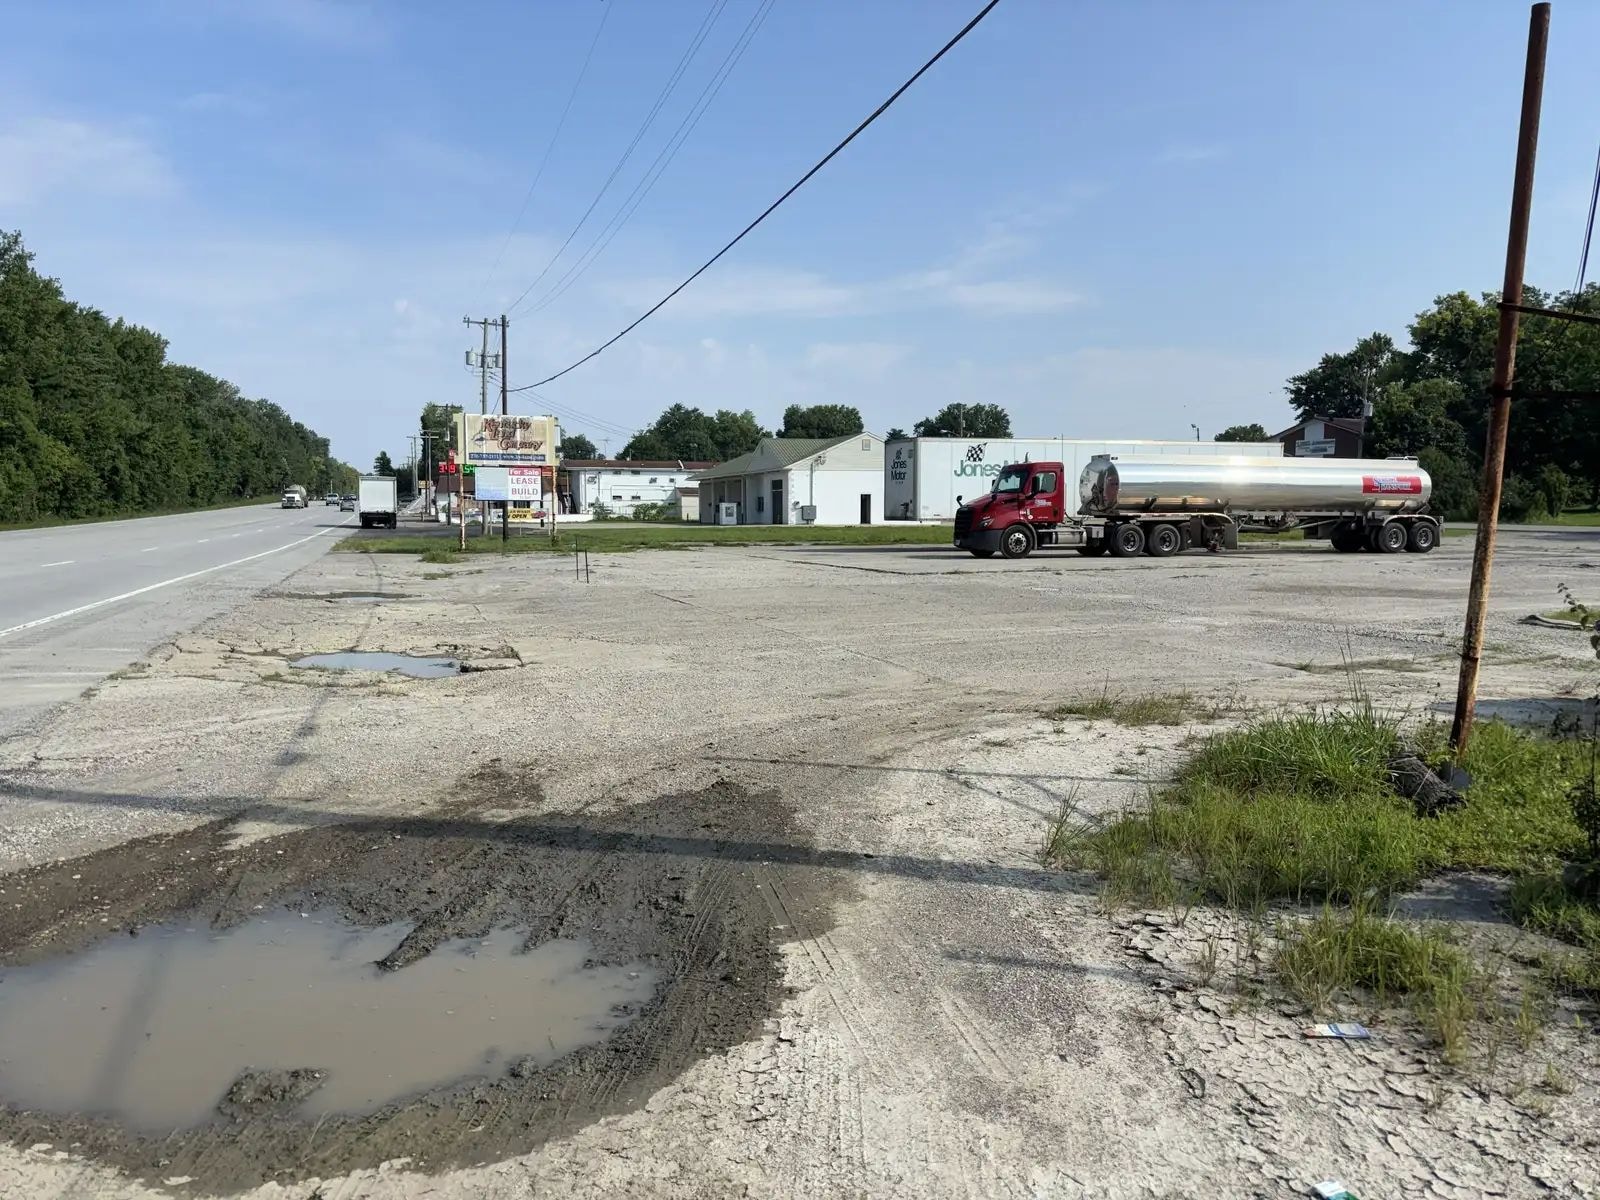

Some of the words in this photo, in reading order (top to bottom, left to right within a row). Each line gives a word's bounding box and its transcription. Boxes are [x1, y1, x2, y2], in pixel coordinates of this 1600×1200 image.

[498, 438, 543, 450] Company
[891, 460, 907, 469] Jones
[954, 460, 1001, 477] Jones
[891, 470, 906, 480] Motor
[511, 477, 539, 485] LEASE
